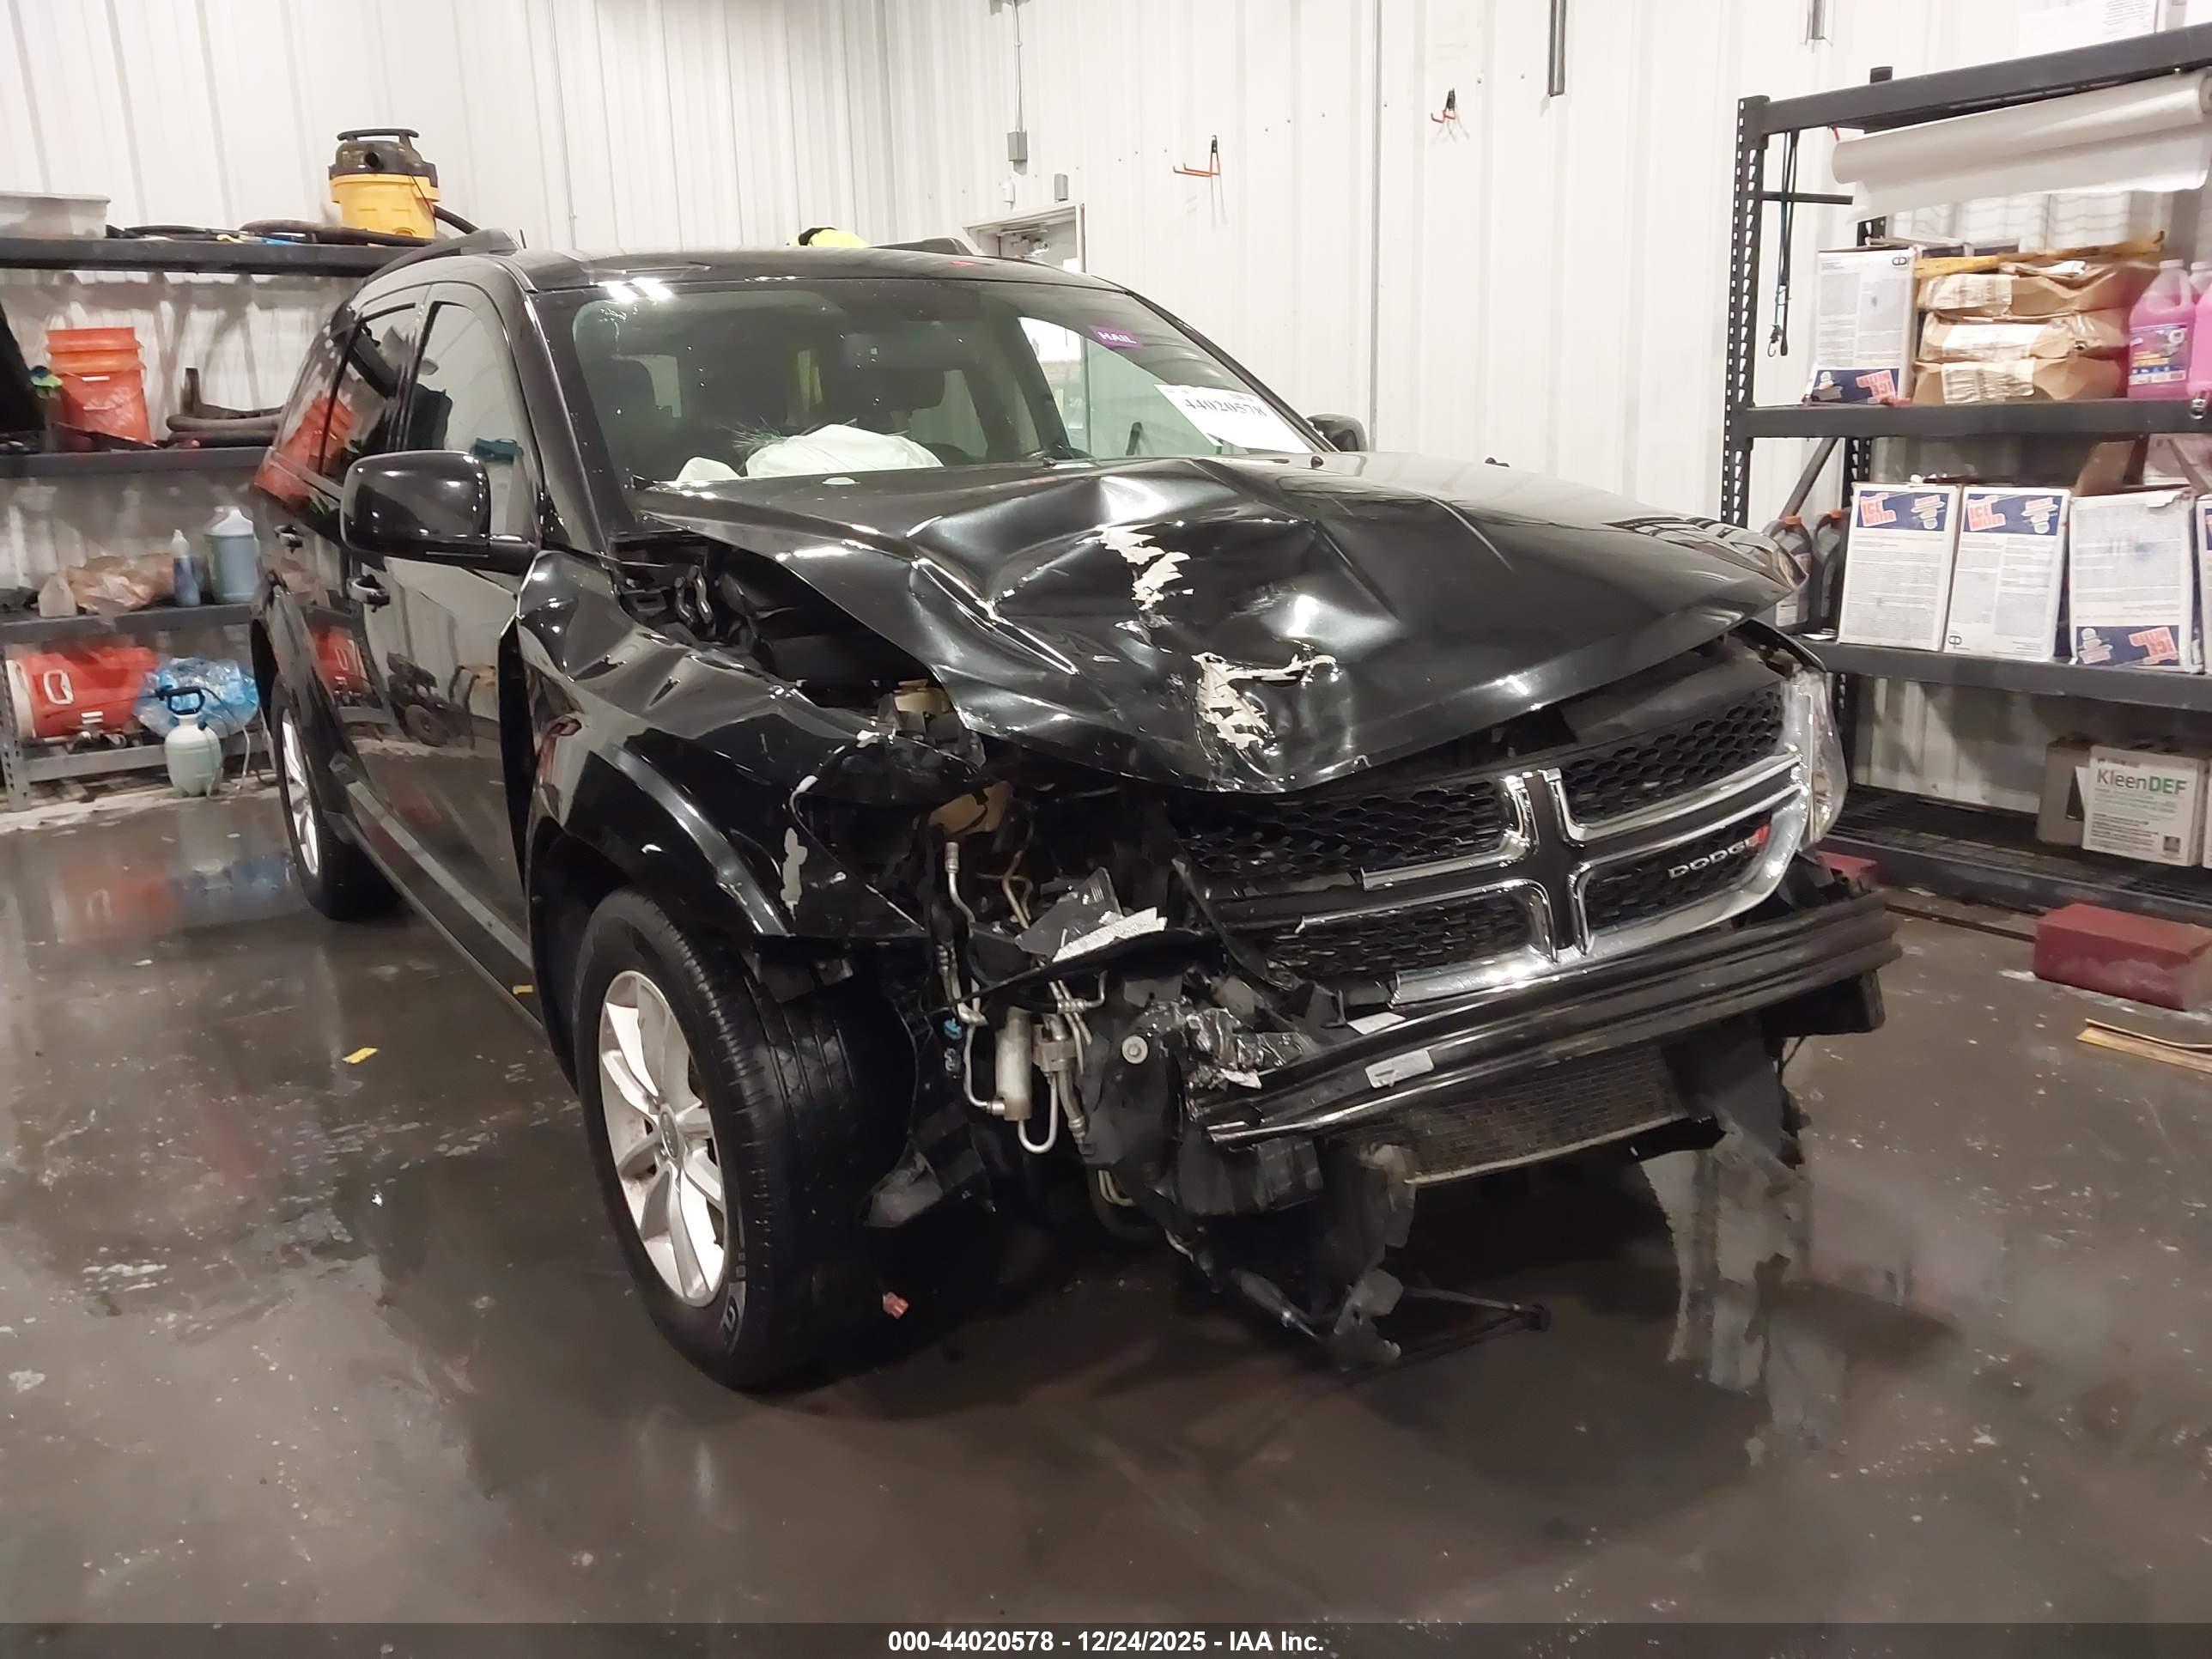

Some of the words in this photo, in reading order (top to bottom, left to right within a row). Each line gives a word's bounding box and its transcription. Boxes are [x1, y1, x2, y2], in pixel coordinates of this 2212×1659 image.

[1097, 331, 1137, 344] HAIL
[1184, 398, 1268, 417] 44020578
[1863, 501, 1882, 515] ICE
[2097, 769, 2188, 795] KleenDEF
[1668, 835, 1758, 879] DODGE
